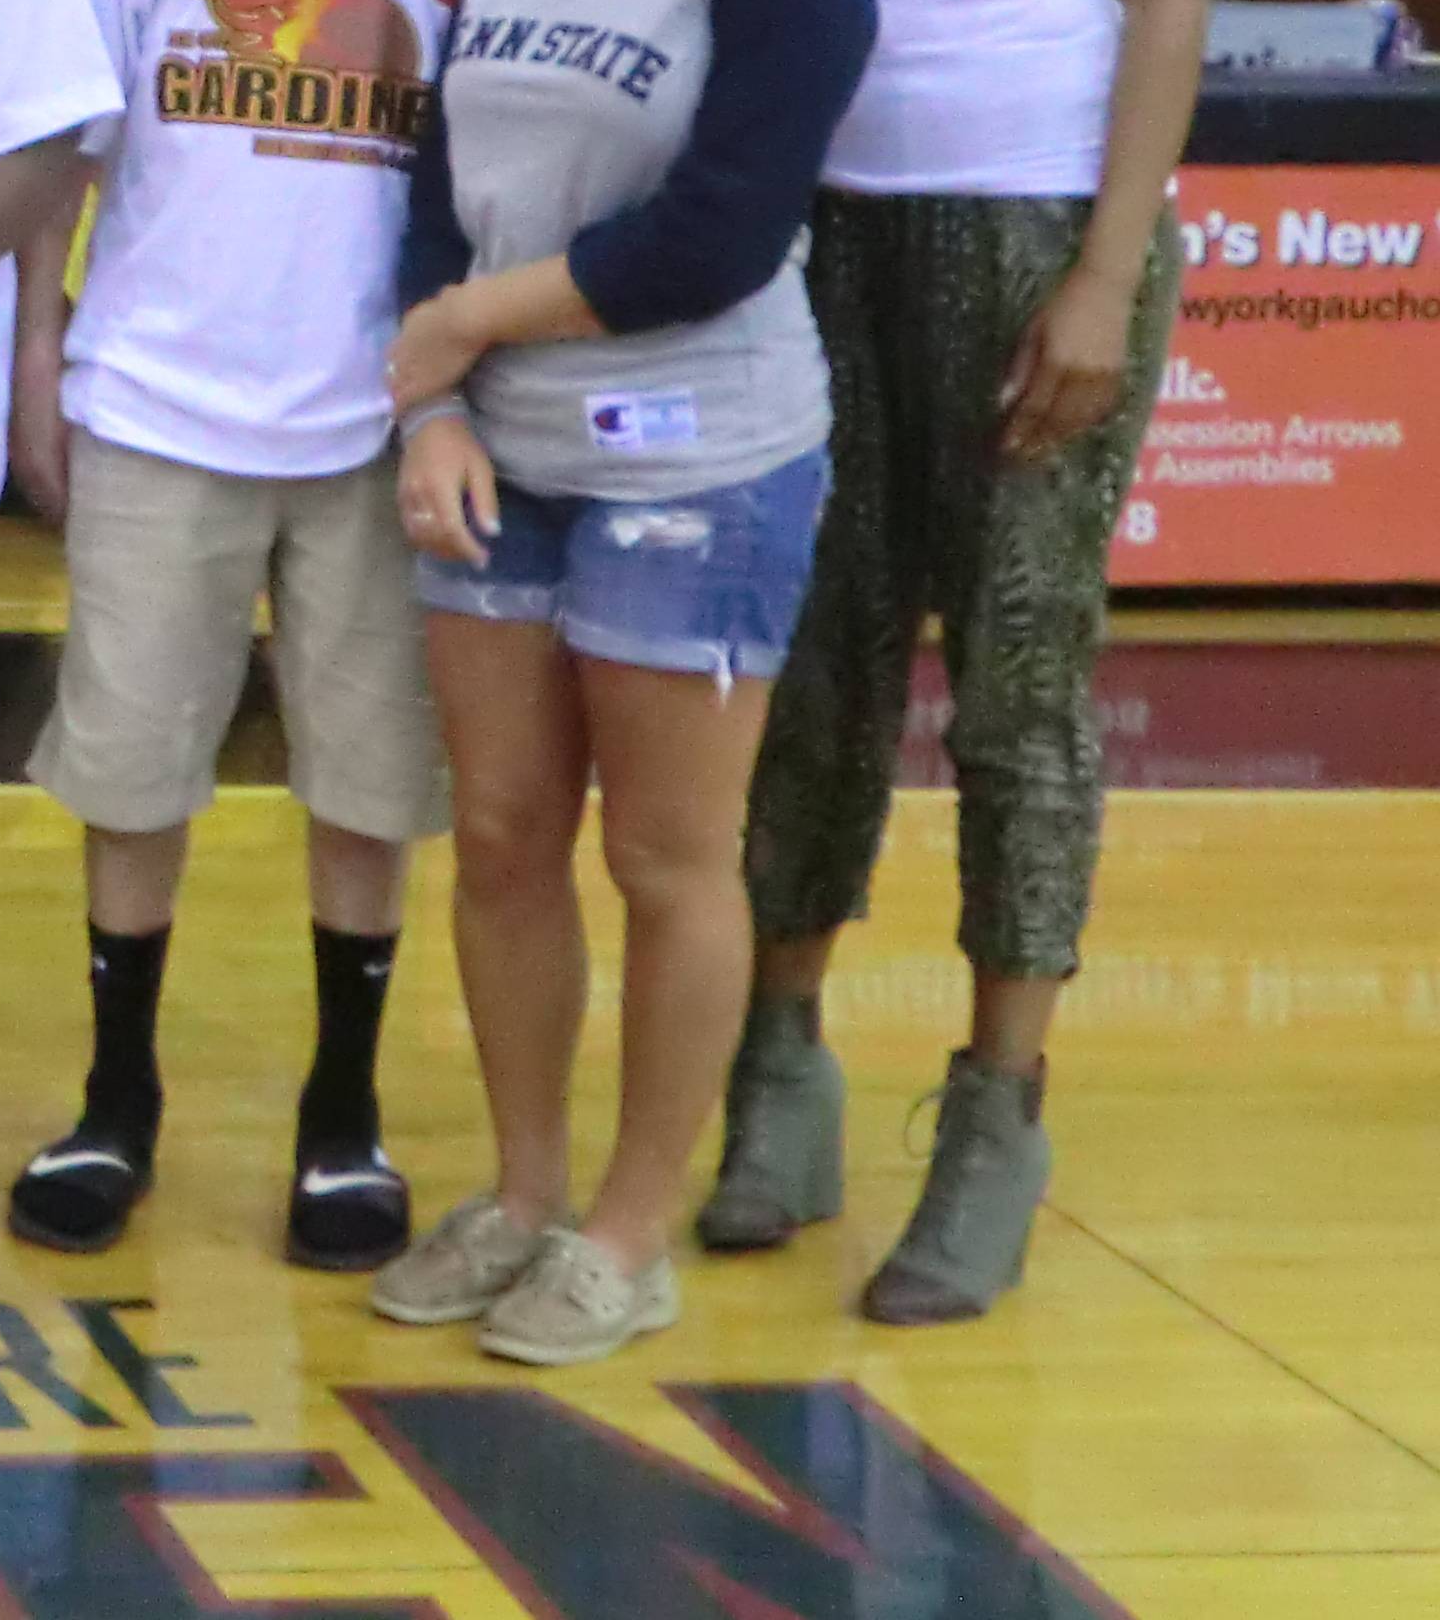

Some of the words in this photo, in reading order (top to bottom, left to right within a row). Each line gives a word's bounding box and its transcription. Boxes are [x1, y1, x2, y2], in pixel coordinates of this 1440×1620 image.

[529, 22, 671, 102] STATE
[1277, 207, 1424, 267] New
[1282, 413, 1405, 451] Arrows
[1153, 450, 1335, 486] Assemblies
